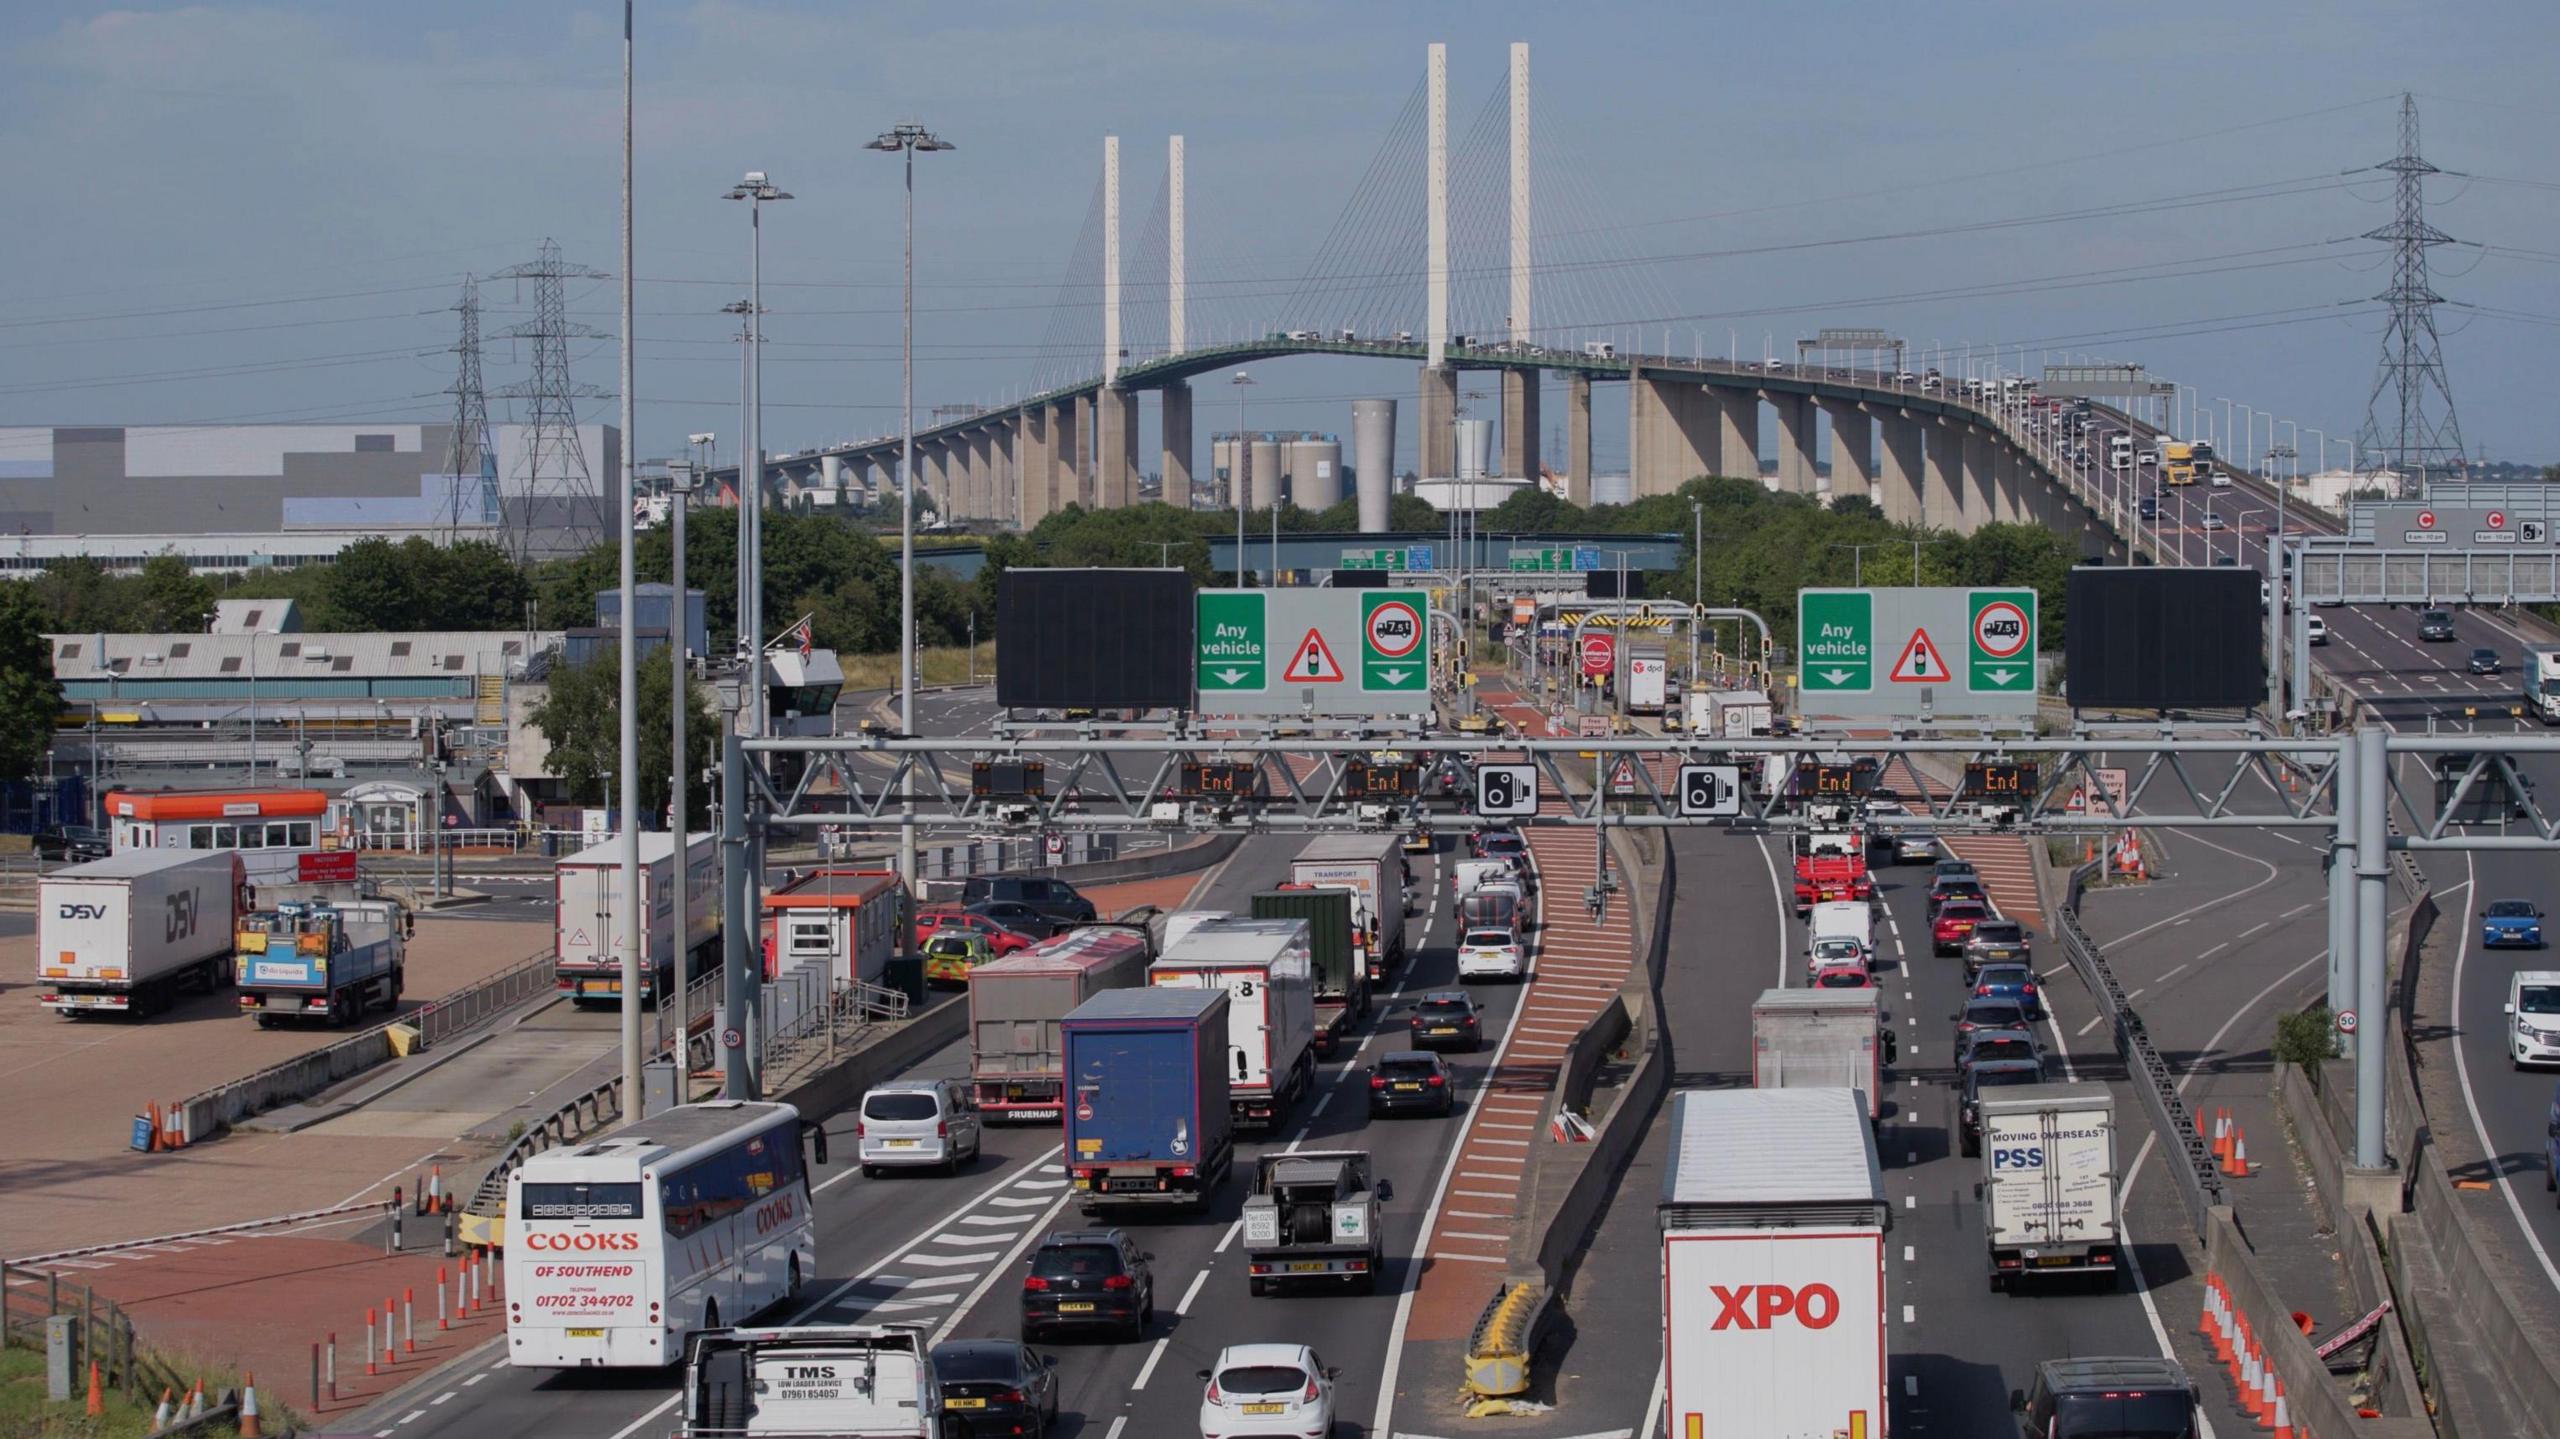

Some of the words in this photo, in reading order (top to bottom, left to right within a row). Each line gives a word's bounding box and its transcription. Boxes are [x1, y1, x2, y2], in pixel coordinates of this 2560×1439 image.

[1215, 623, 1247, 640] Any
[1821, 623, 1853, 640] Any
[1202, 641, 1261, 655] vehicle
[1807, 642, 1867, 655] vehicle
[1647, 664, 1663, 673] dpd
[1201, 768, 1233, 791] End
[1367, 768, 1399, 791] End
[1819, 768, 1850, 791] End
[1986, 768, 2018, 791] End
[60, 904, 106, 919] DSV
[166, 887, 199, 944] DSV
[2341, 1016, 2354, 1025] 50
[725, 1034, 737, 1042] 50
[1008, 1110, 1058, 1118] FRUEHAUF
[1993, 1132, 2037, 1142] MOVING
[2041, 1129, 2105, 1140] OVERSEAS?
[1993, 1147, 2043, 1169] PSS
[756, 1192, 792, 1235] COOKS
[527, 1232, 639, 1251] COOKS
[535, 1266, 555, 1277] OF
[557, 1266, 633, 1277] SOUTHEND
[536, 1296, 576, 1308] 01702
[580, 1296, 634, 1307] 344702
[1709, 1283, 1840, 1330] XPO
[784, 1366, 836, 1378] TMS
[782, 1390, 806, 1399] 07961
[808, 1389, 839, 1398] 854057
